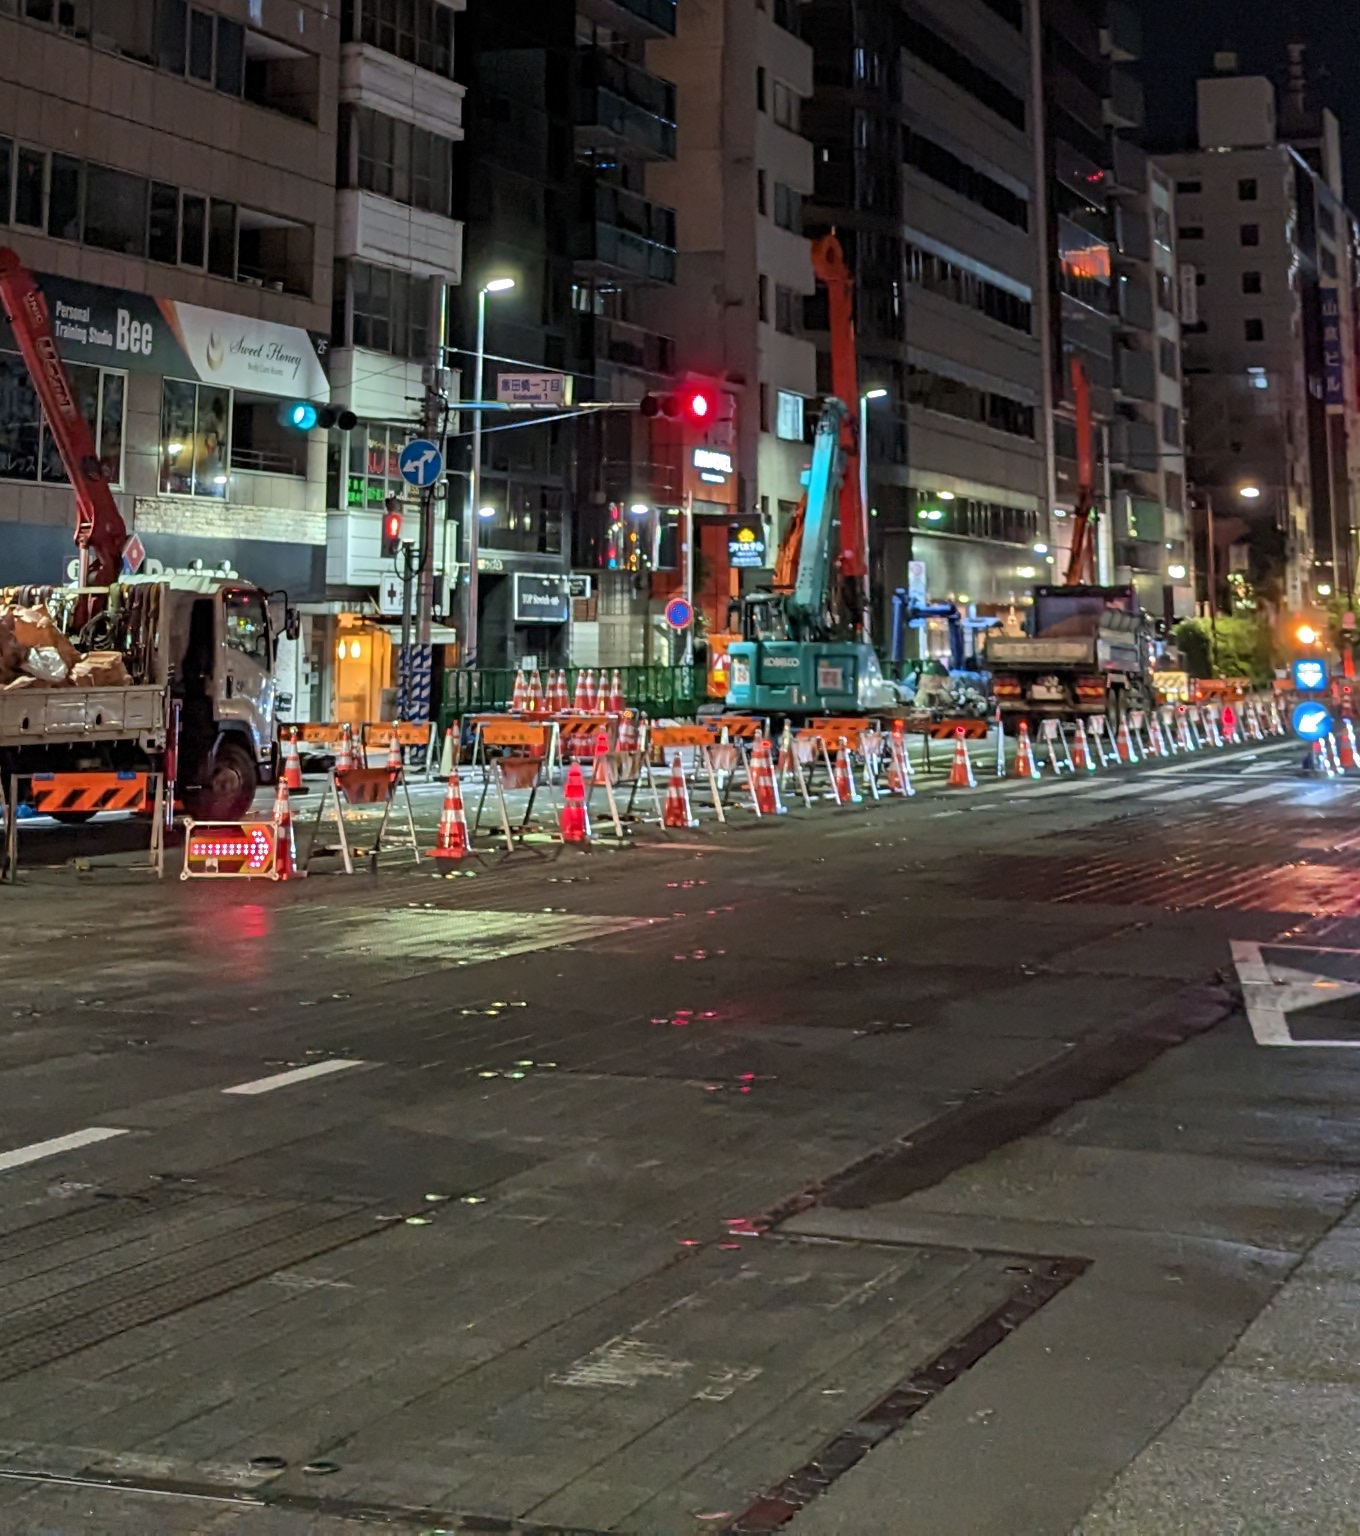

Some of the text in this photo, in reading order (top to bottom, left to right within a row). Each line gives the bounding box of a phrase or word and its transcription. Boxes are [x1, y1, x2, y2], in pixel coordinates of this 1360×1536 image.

[56, 300, 90, 323] Personal
[55, 320, 113, 347] Training Studio
[116, 308, 153, 356] Bee
[229, 335, 302, 381] Sweet Honey
